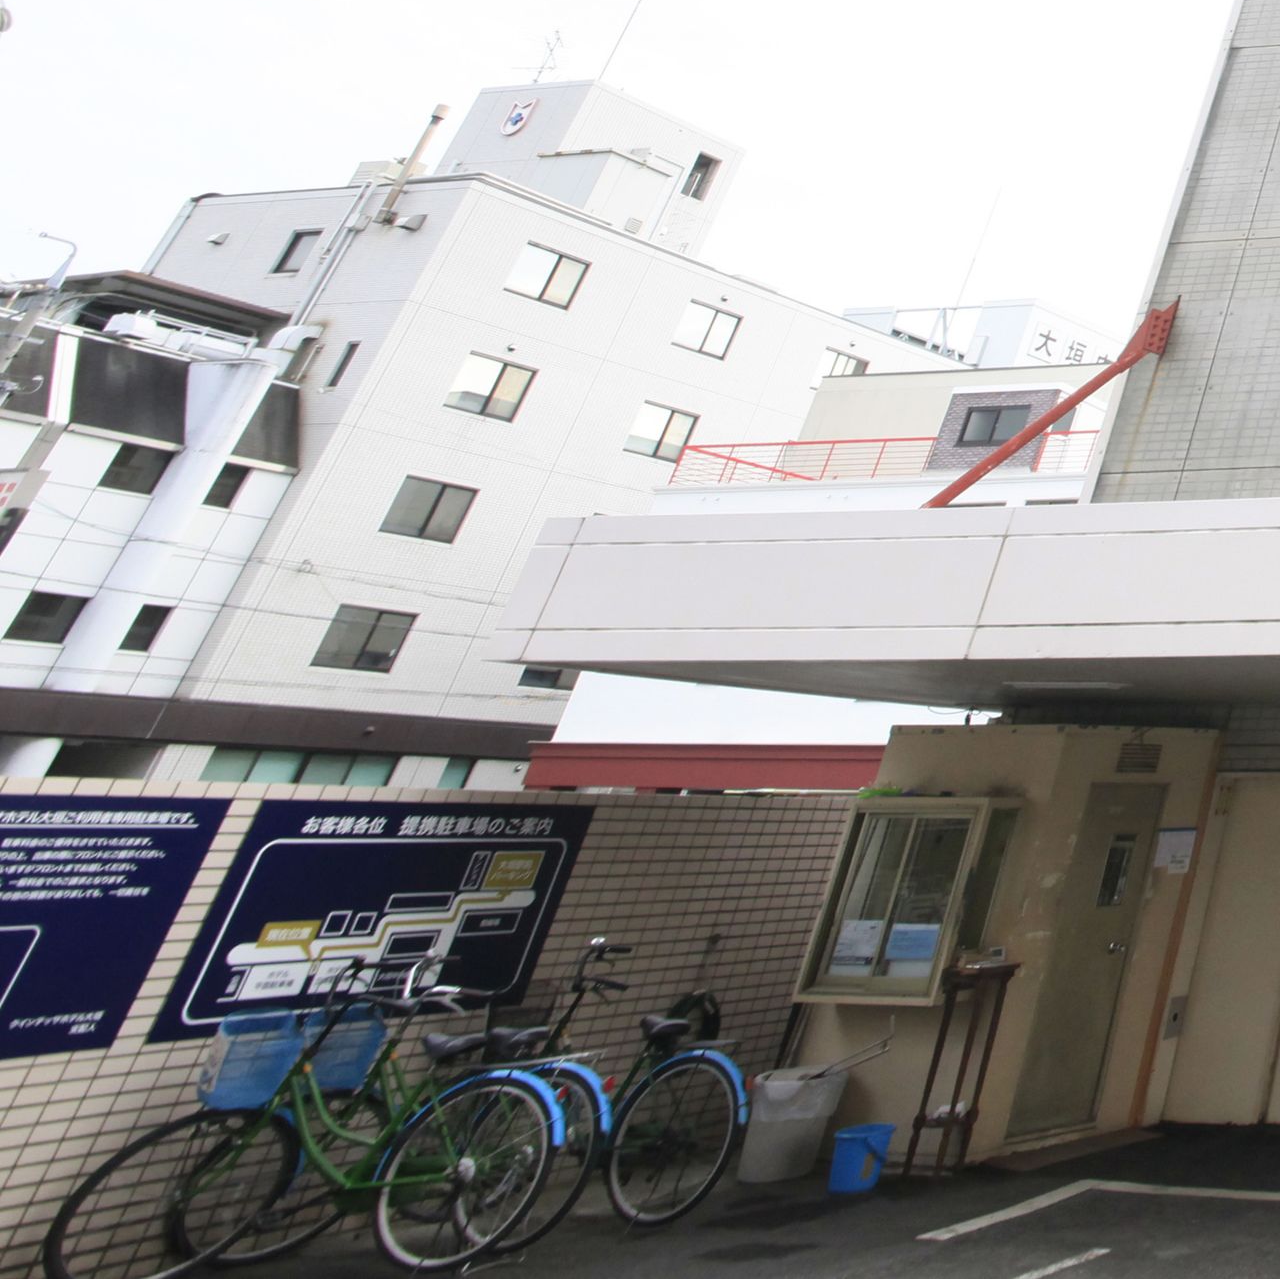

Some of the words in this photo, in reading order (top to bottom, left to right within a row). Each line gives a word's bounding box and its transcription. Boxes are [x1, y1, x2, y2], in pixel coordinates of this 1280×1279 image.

[301, 815, 388, 835] お客様各位
[397, 815, 554, 836] 提携駐車場のご案内
